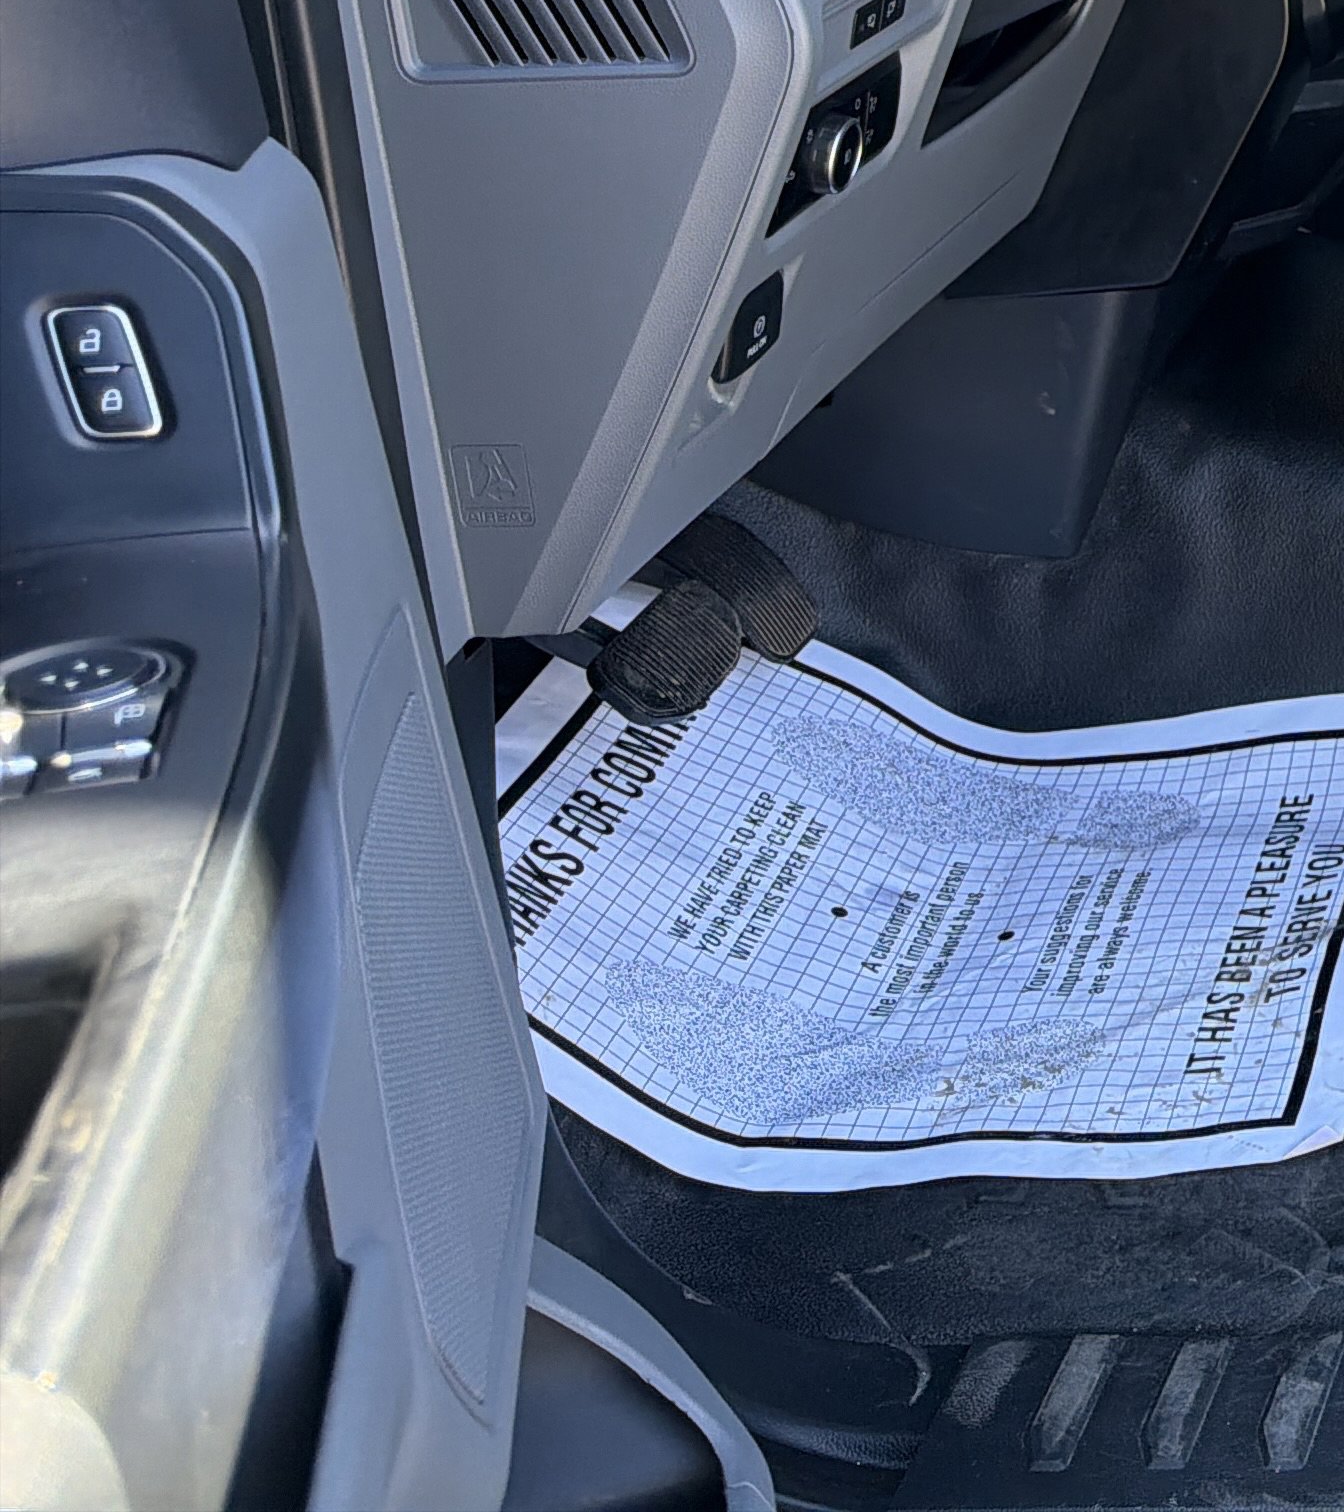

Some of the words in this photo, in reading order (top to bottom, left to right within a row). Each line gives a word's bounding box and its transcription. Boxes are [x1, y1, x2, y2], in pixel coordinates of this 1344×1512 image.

[466, 510, 534, 524] AIRBAG
[506, 839, 584, 947] ANKS
[550, 790, 629, 852] FOR
[591, 716, 697, 798] COMI
[1246, 793, 1314, 899] PLEASURE
[667, 915, 696, 939] WE
[683, 880, 719, 919] HAVE
[706, 847, 742, 885] TRIED
[729, 827, 756, 846] TO
[743, 791, 776, 827] KEEP
[695, 916, 735, 954] YOUR
[721, 846, 778, 917] CARPETING
[767, 800, 807, 846] CLEAN
[727, 923, 765, 961] WITH
[752, 892, 785, 923] THIS
[771, 851, 810, 893] PAPER
[797, 817, 828, 850] MAT
[903, 890, 921, 903] is
[1093, 868, 1123, 908] service
[870, 903, 914, 960] customer
[953, 908, 975, 923] to
[1085, 911, 1103, 931] our
[1239, 904, 1277, 920] A
[1278, 889, 1333, 964] SERVE
[868, 998, 897, 1017] the
[885, 961, 915, 995] most
[902, 902, 945, 962] important
[936, 861, 970, 903] person
[939, 921, 968, 958] world
[1021, 967, 1052, 993] Your
[1040, 891, 1085, 964] suggestions
[1071, 874, 1095, 890] for
[1097, 926, 1130, 970] always
[1214, 924, 1269, 984] BEEN
[861, 961, 882, 974] A
[923, 960, 949, 985] the
[1050, 934, 1100, 997] improving
[1088, 974, 1110, 995] are
[1264, 966, 1307, 1004] TO
[913, 983, 935, 995] in
[1194, 991, 1245, 1043] HAS
[1184, 1052, 1226, 1075] IT
